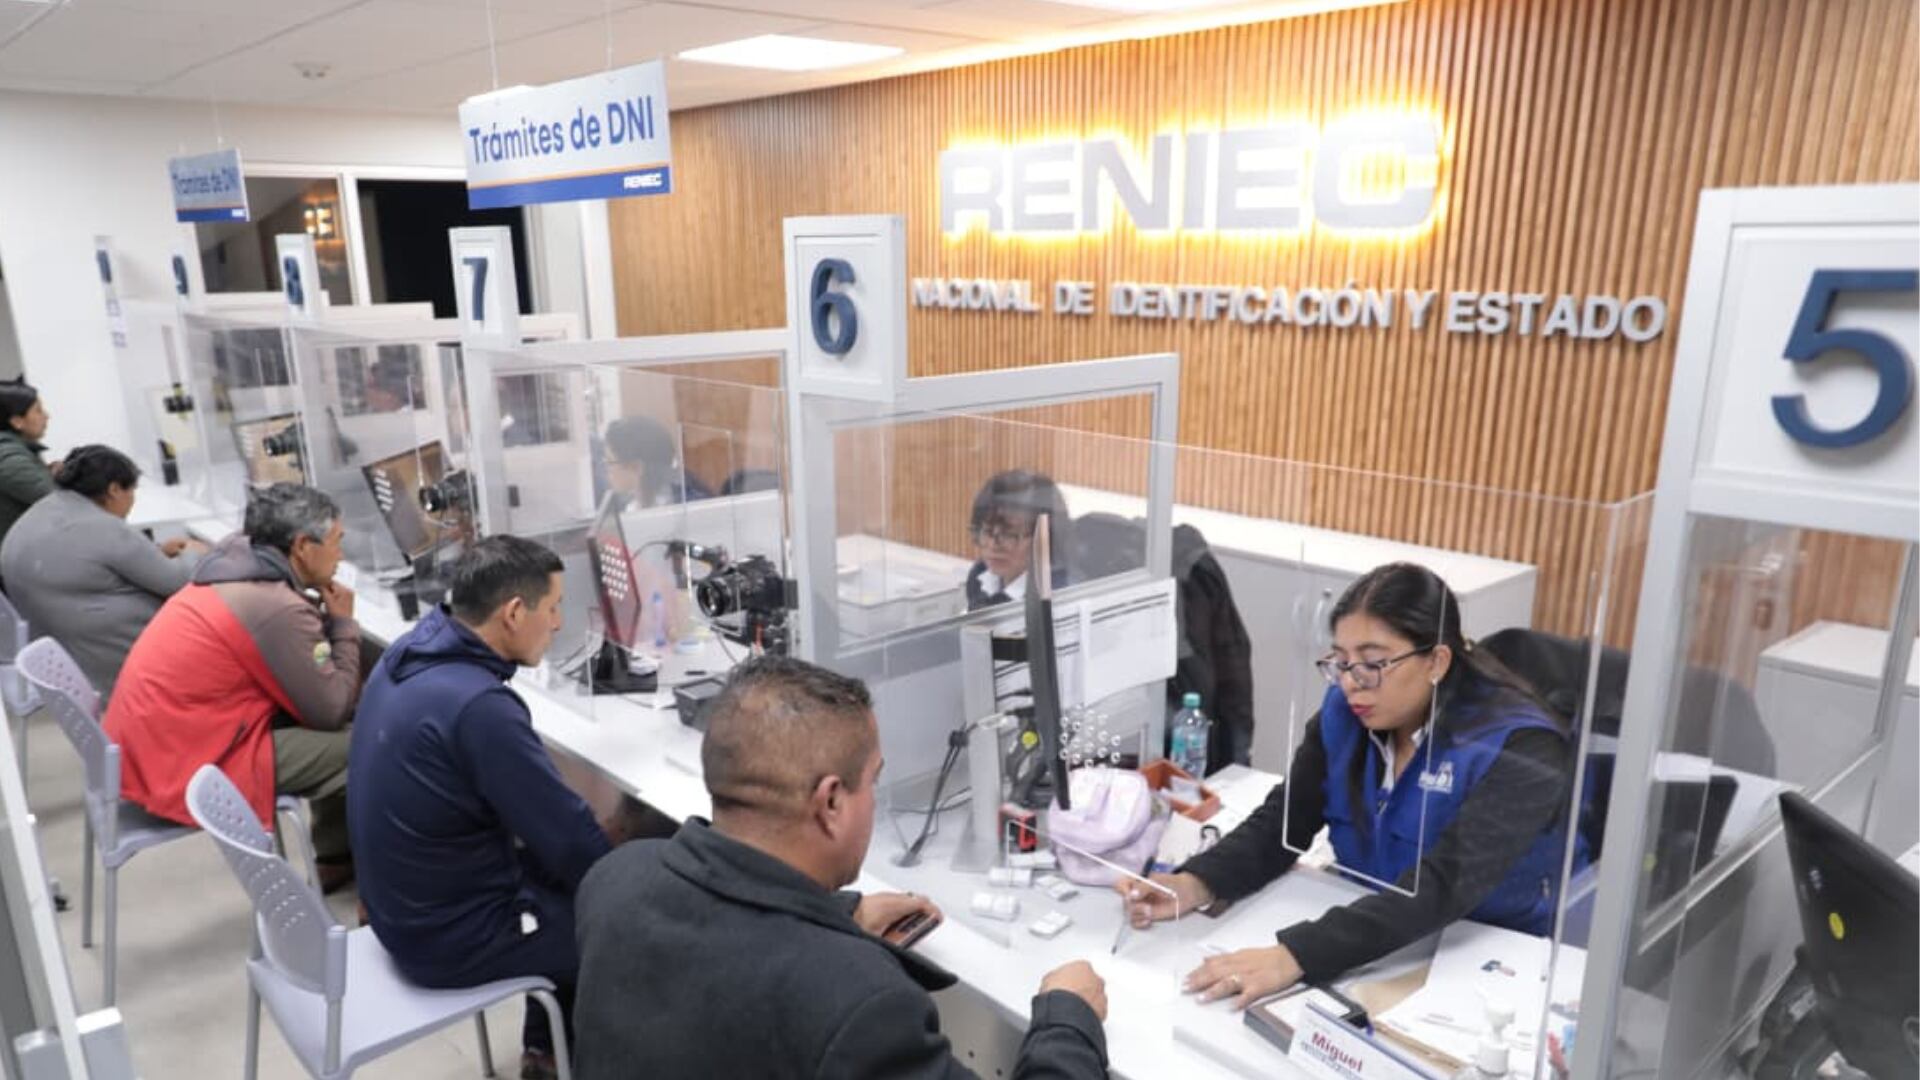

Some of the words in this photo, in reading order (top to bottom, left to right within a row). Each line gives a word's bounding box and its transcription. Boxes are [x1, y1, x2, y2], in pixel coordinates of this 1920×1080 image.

[468, 116, 565, 164] Trámites
[570, 107, 601, 150] de
[607, 94, 654, 145] DNI
[940, 116, 1437, 232] RENIEC
[284, 256, 304, 305] 8
[463, 257, 488, 321] 7
[810, 257, 859, 356] 6
[912, 278, 1041, 313] NACIONAL
[1054, 281, 1095, 315] DE
[1110, 280, 1394, 328] IDENTIFICACIÓN
[1405, 289, 1437, 329] Y
[1446, 291, 1667, 342] ESTADO
[1771, 268, 1919, 450] 5
[1311, 1031, 1363, 1073] Miguel
